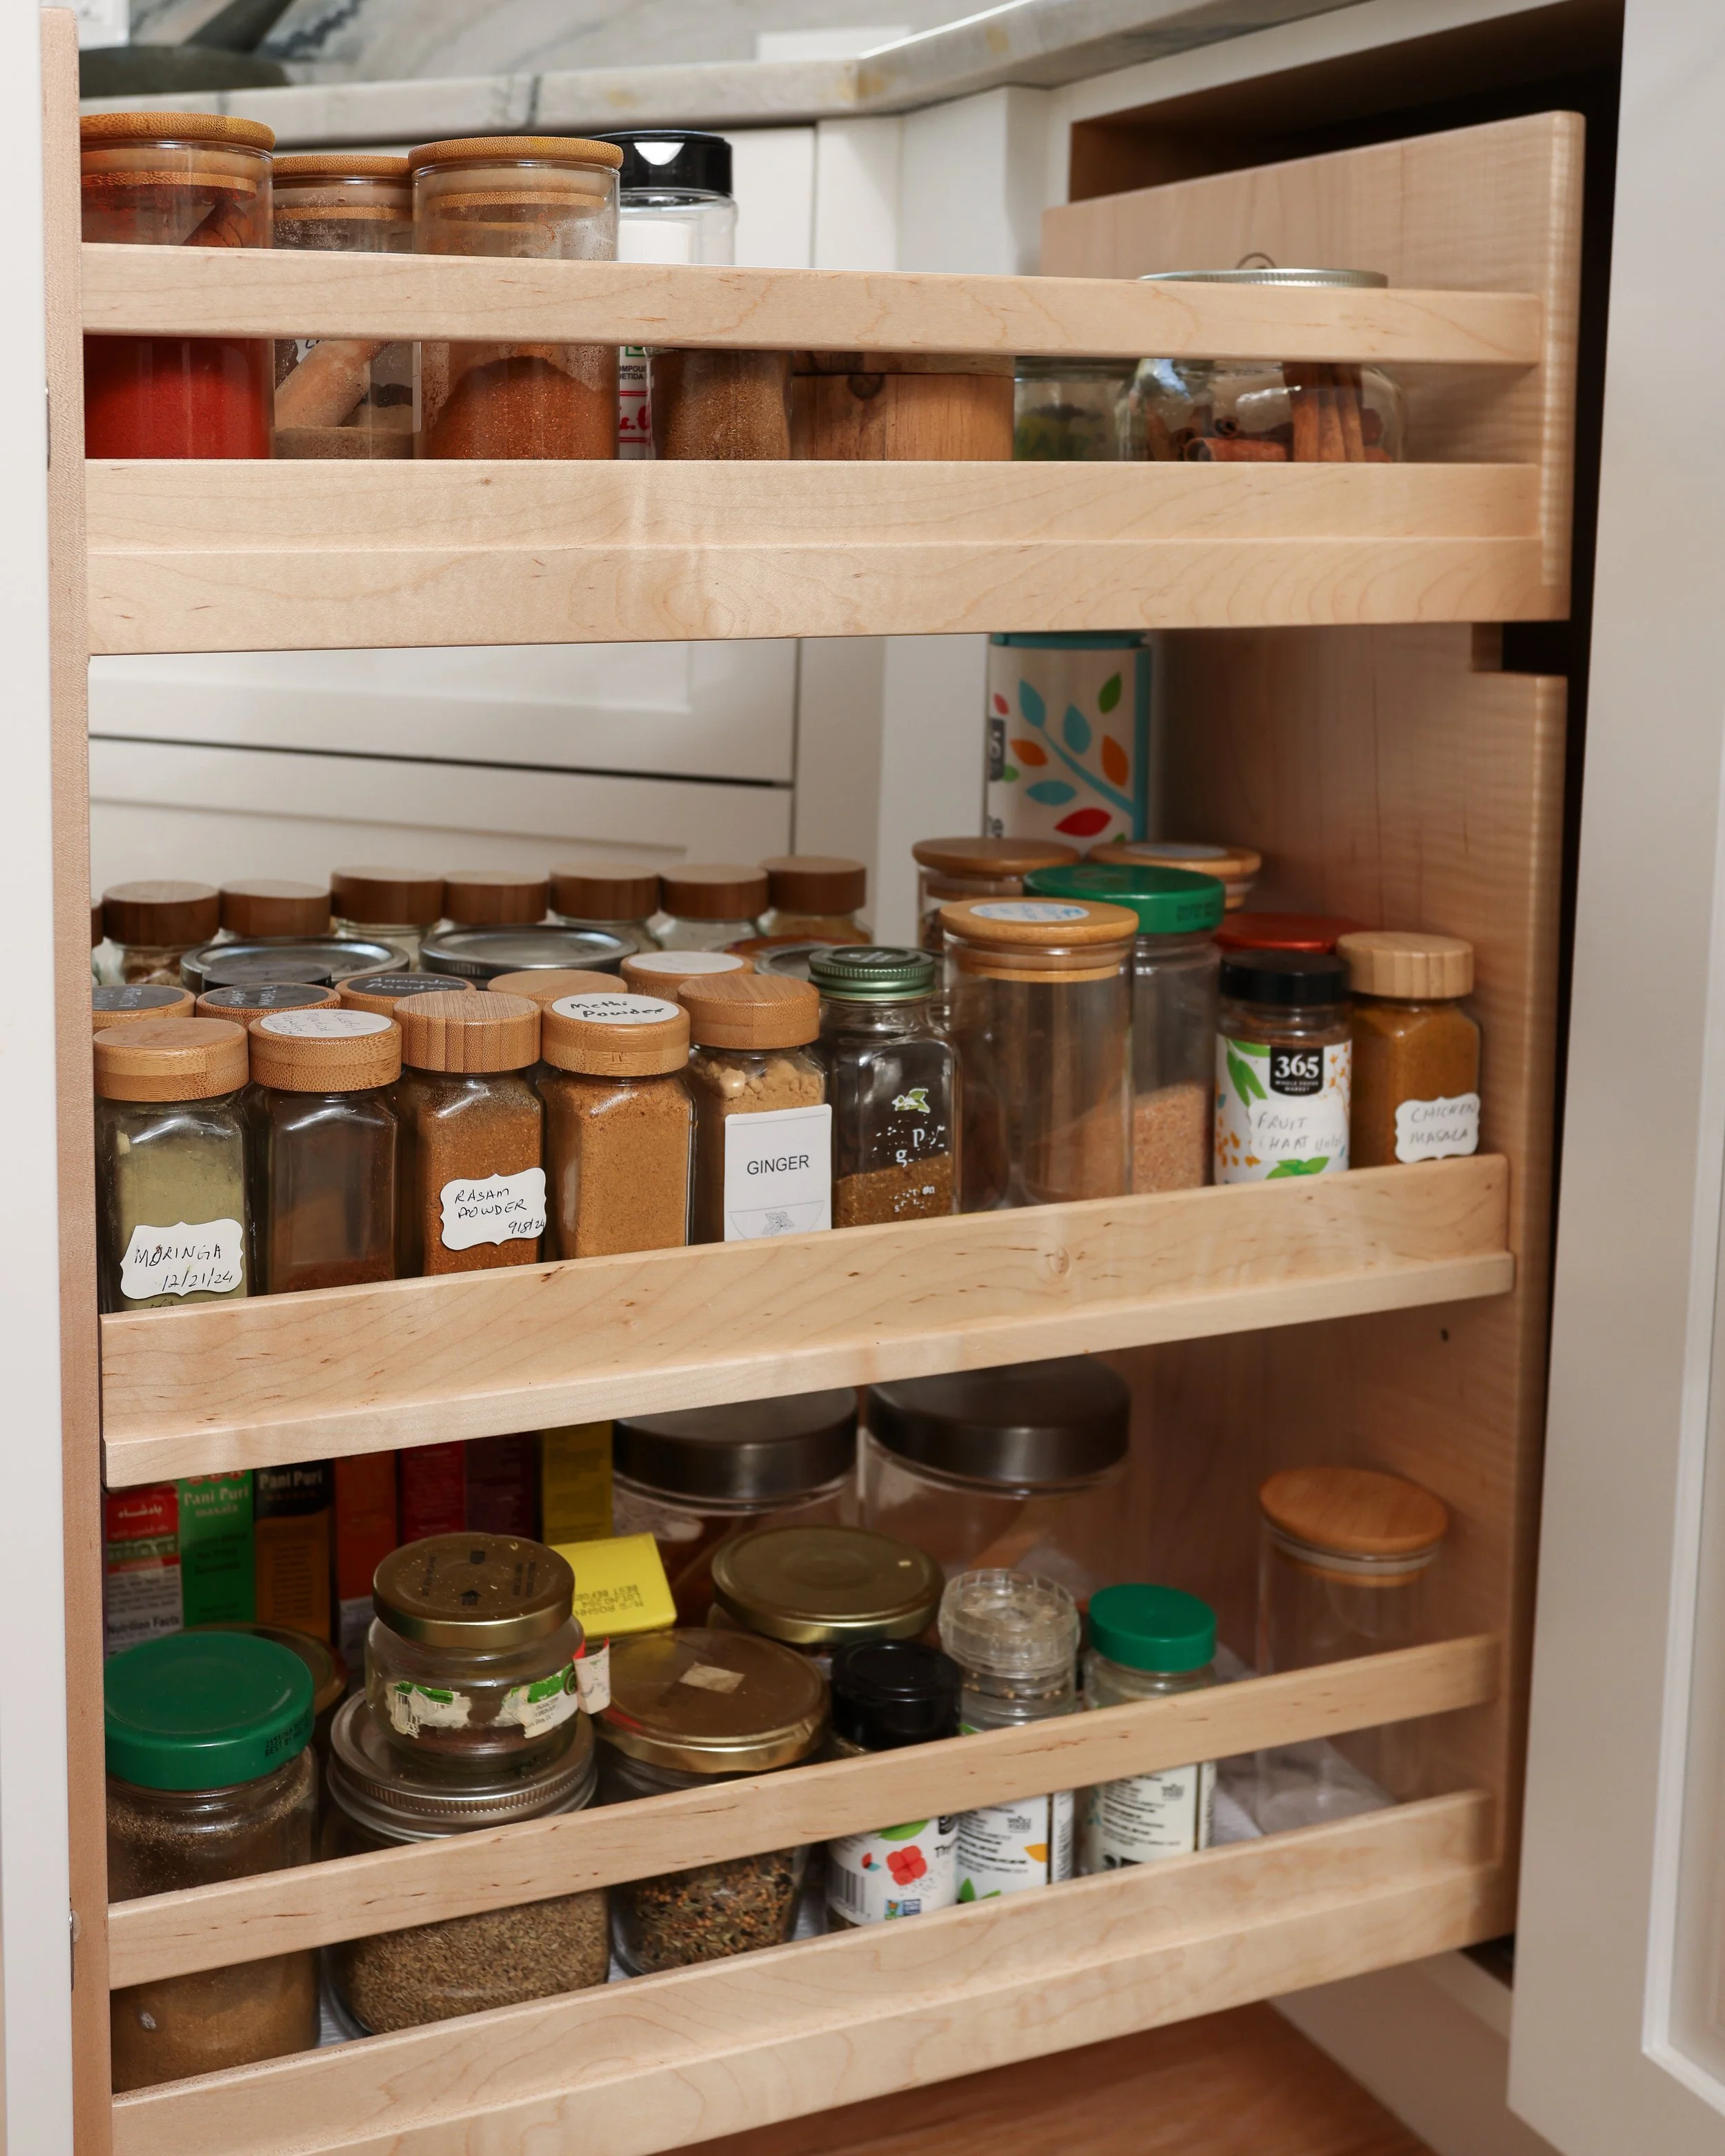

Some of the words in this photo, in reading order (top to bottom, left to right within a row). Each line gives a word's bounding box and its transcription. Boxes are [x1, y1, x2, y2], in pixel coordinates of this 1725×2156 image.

[582, 1008, 664, 1018] Powder
[1274, 1054, 1320, 1078] 365
[1257, 1111, 1308, 1131] FRUIT
[1259, 1136, 1308, 1151] CHAAT
[1410, 1128, 1468, 1145] MASALA
[747, 1155, 809, 1175] GINGER
[457, 1198, 527, 1219] POWDER
[134, 1243, 221, 1267] MORINGA
[161, 1267, 233, 1292] 12/21/24
[184, 1489, 215, 1507] Pani
[219, 1485, 249, 1502] Puri
